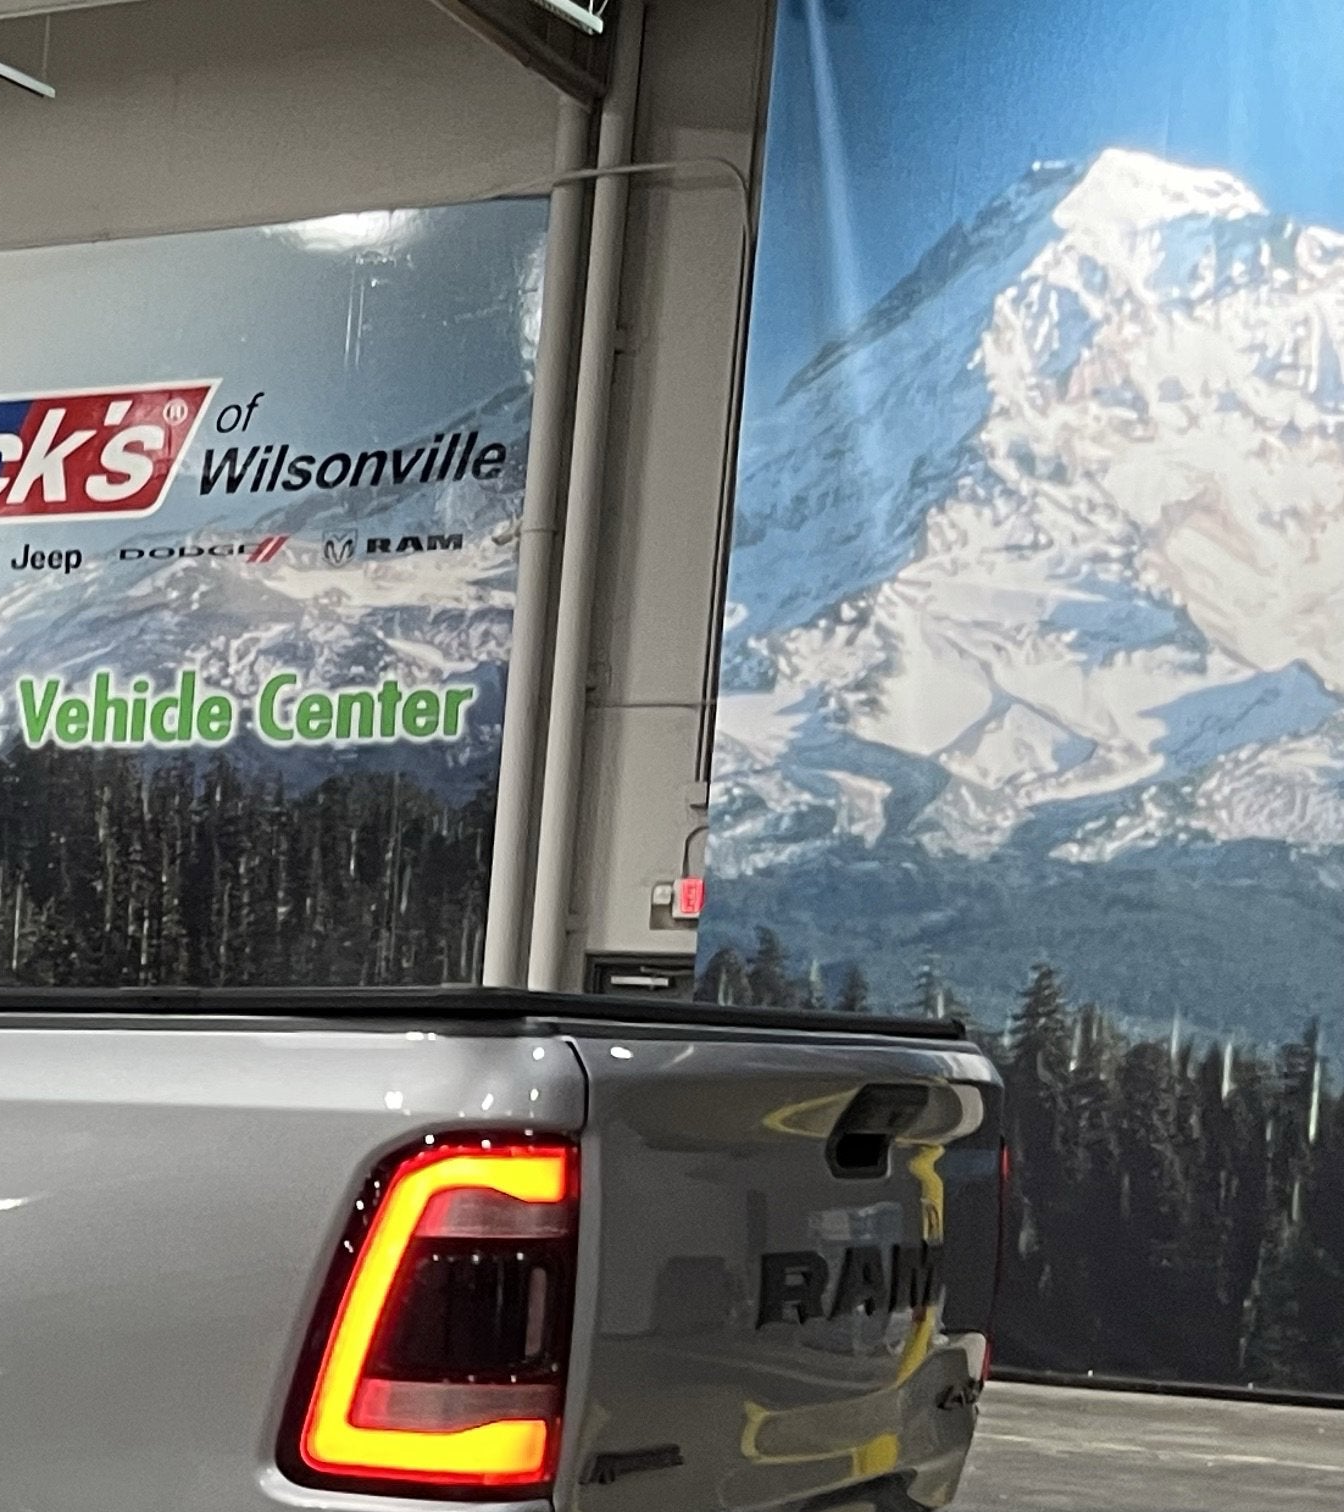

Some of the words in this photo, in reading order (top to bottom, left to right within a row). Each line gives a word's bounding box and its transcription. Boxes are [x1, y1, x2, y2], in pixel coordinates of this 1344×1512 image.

[215, 391, 265, 434] of
[199, 430, 507, 495] Wilsonville
[10, 543, 83, 574] Jeep
[365, 533, 464, 555] RAM
[259, 673, 474, 741] Center
[755, 1238, 942, 1330] RAM
